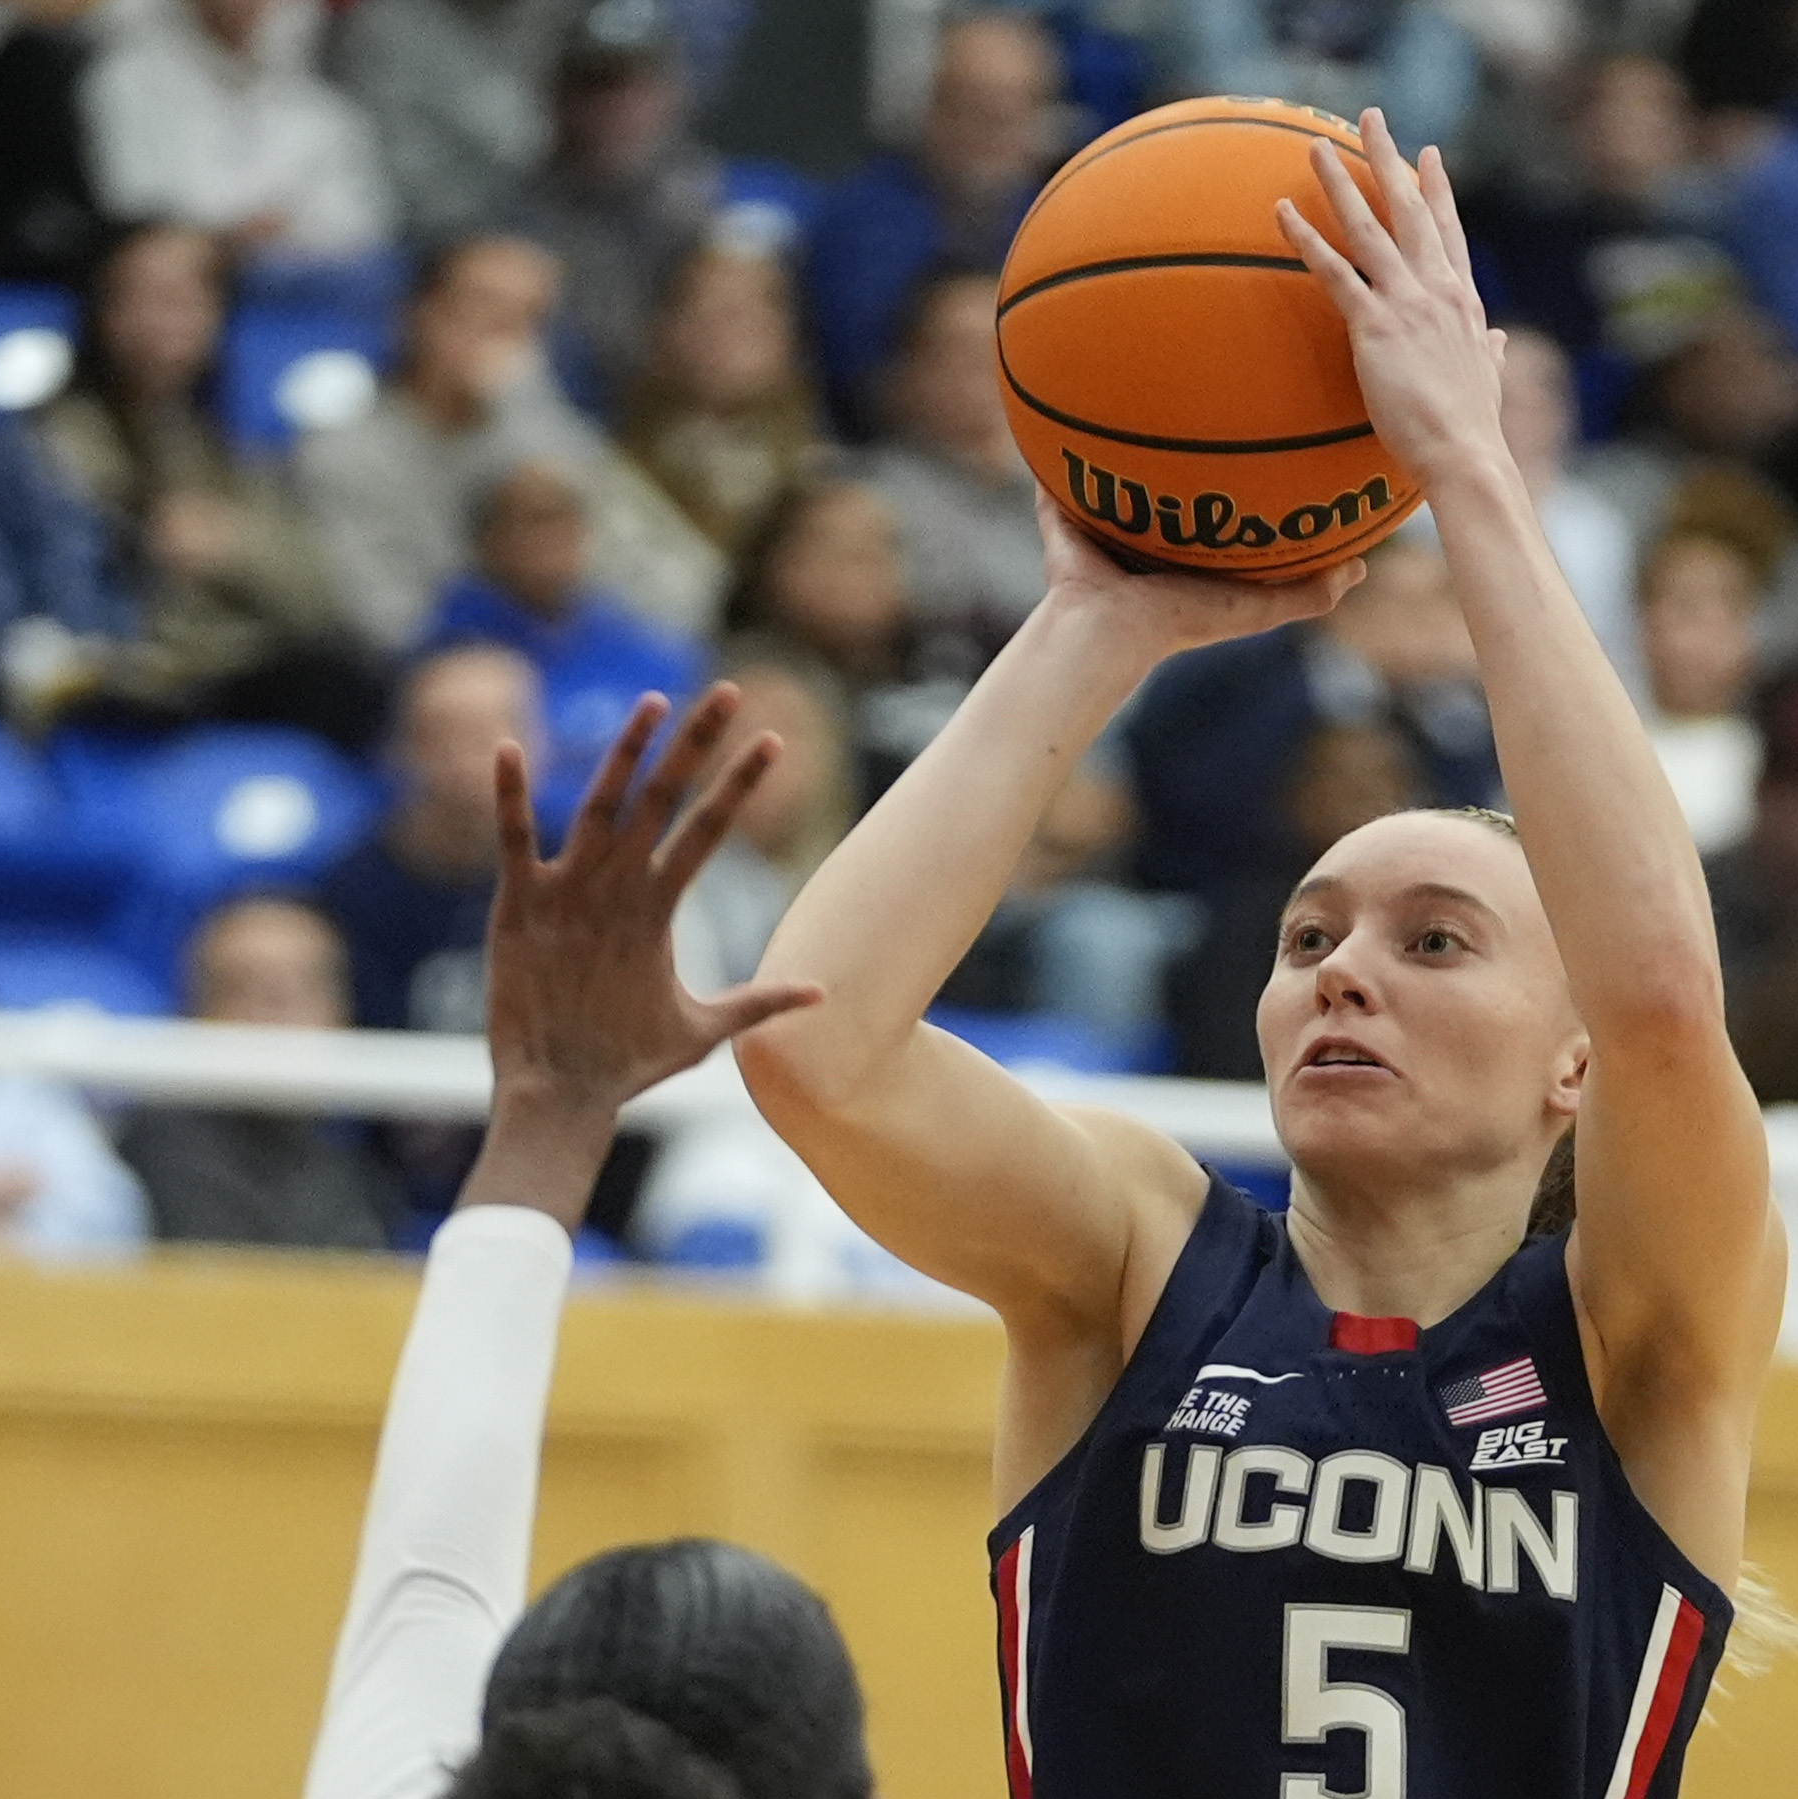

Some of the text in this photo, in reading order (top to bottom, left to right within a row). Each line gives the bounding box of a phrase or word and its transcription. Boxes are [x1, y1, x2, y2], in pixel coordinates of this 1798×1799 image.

[1061, 448, 1393, 549] Wilson
[1178, 1387, 1252, 1418] E THE
[1164, 1408, 1246, 1437] HANGE
[1476, 1420, 1545, 1450] BIG
[1471, 1438, 1569, 1464] EAST
[1139, 1443, 1578, 1602] UCONN
